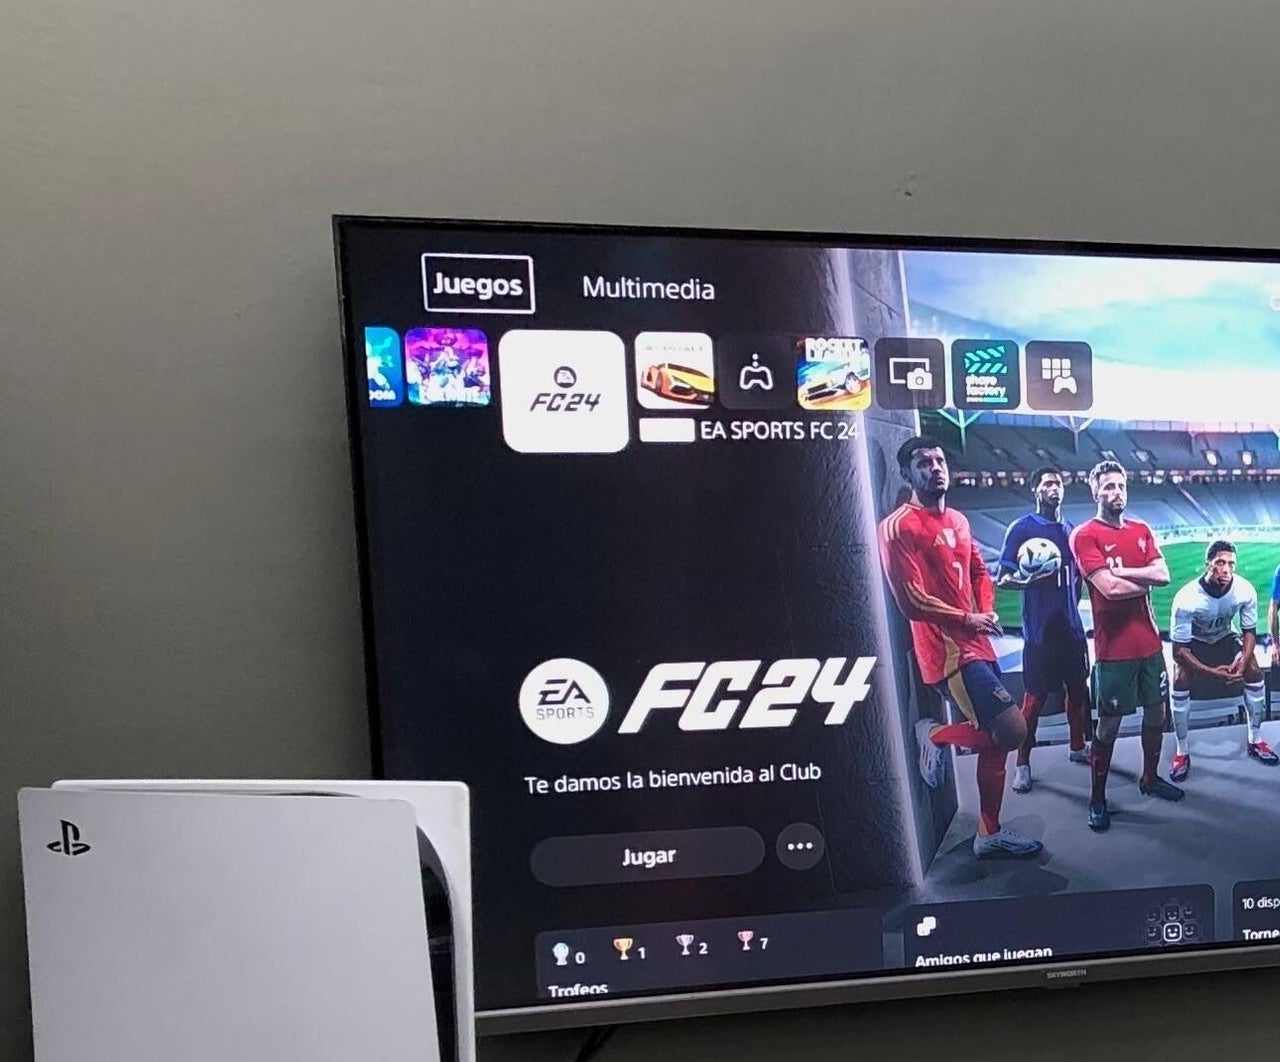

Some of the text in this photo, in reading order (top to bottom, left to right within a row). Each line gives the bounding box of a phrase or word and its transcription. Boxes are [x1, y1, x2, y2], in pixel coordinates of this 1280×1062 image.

[433, 271, 524, 300] Juegos
[582, 275, 716, 300] Multimedia
[700, 420, 858, 440] EA SPORTS FC 24
[538, 679, 592, 705] EA
[536, 706, 595, 721] SPORTS
[524, 762, 822, 794] Te damos la bienvenida al Club
[622, 847, 677, 868] Jugar
[1242, 897, 1254, 910] 10
[637, 946, 647, 959] 1
[698, 942, 708, 955] 2
[760, 937, 769, 950] 7
